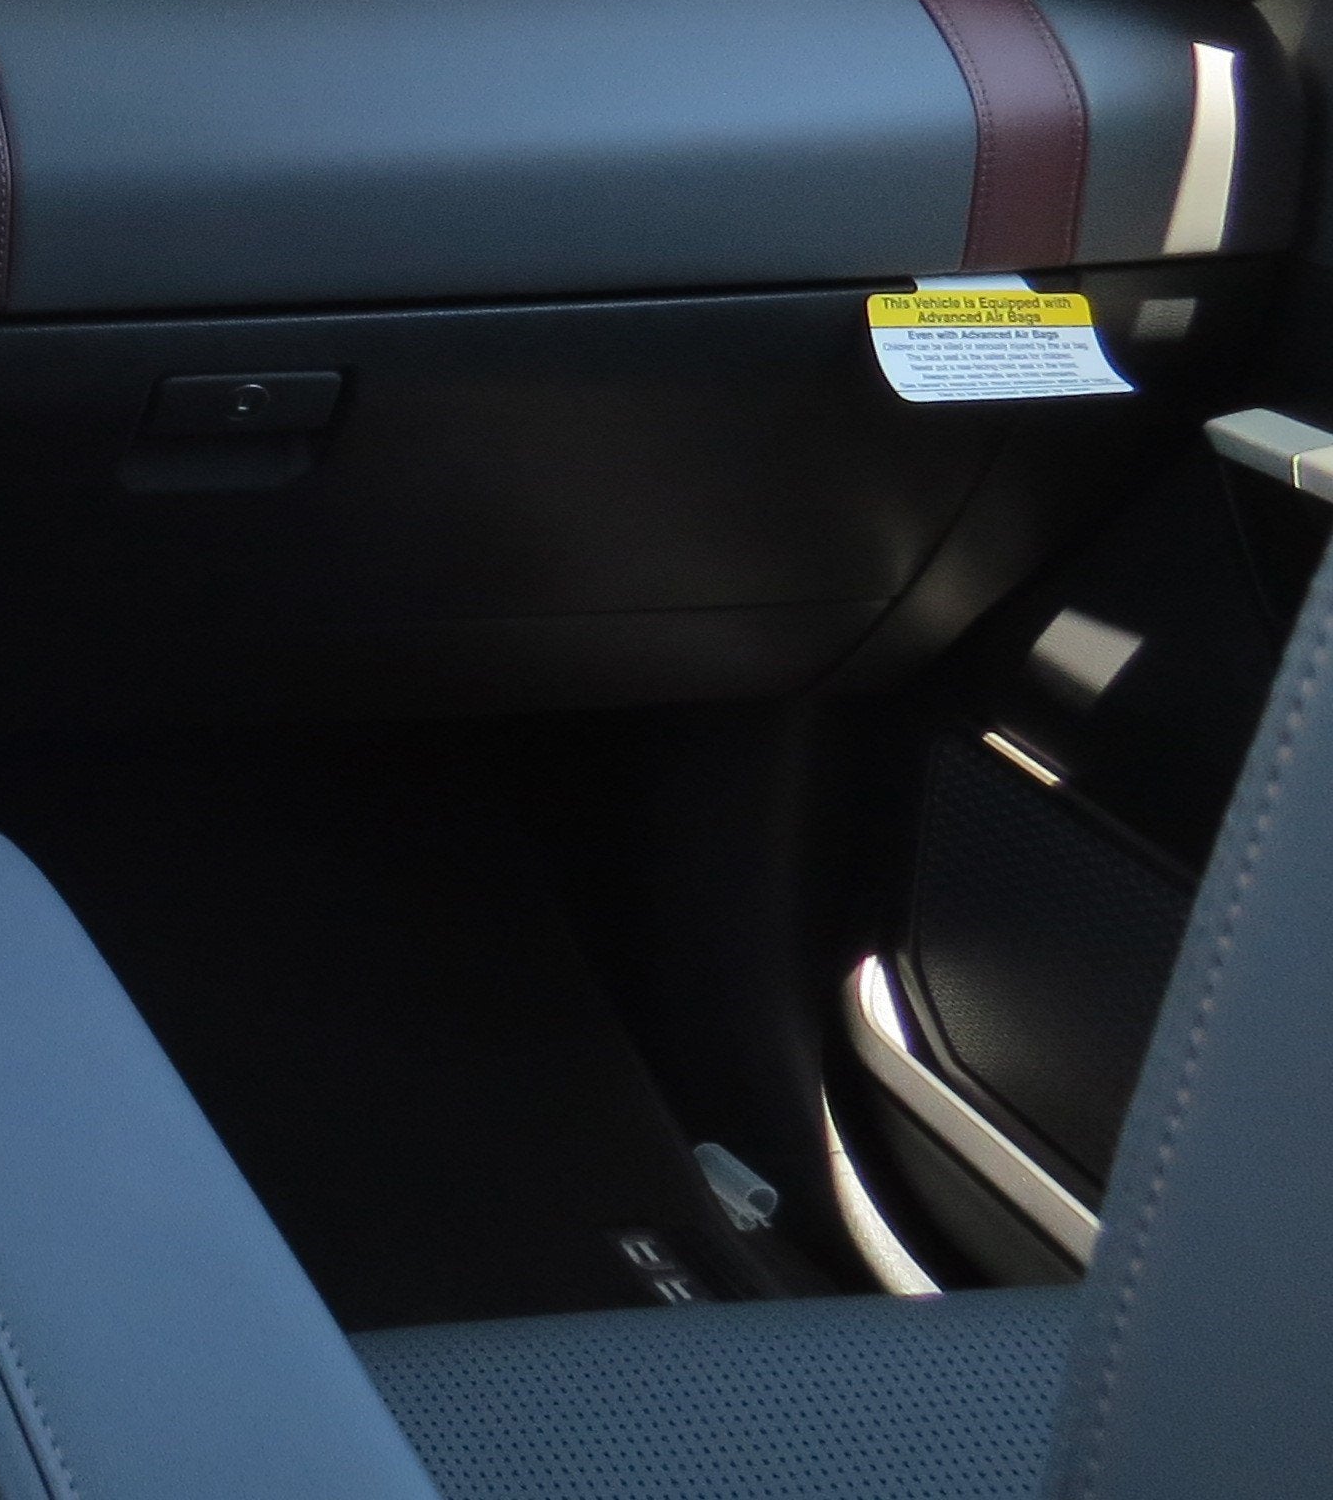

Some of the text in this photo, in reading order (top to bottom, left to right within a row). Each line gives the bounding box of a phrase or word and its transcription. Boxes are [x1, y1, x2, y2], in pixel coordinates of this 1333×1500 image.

[883, 296, 910, 309] This
[913, 296, 960, 309] Vehicle
[978, 296, 1040, 311] Equipped
[1043, 296, 1072, 309] with
[918, 311, 1041, 326] Advanced Air Bags
[907, 329, 1060, 341] Even with Advanced Air Bags
